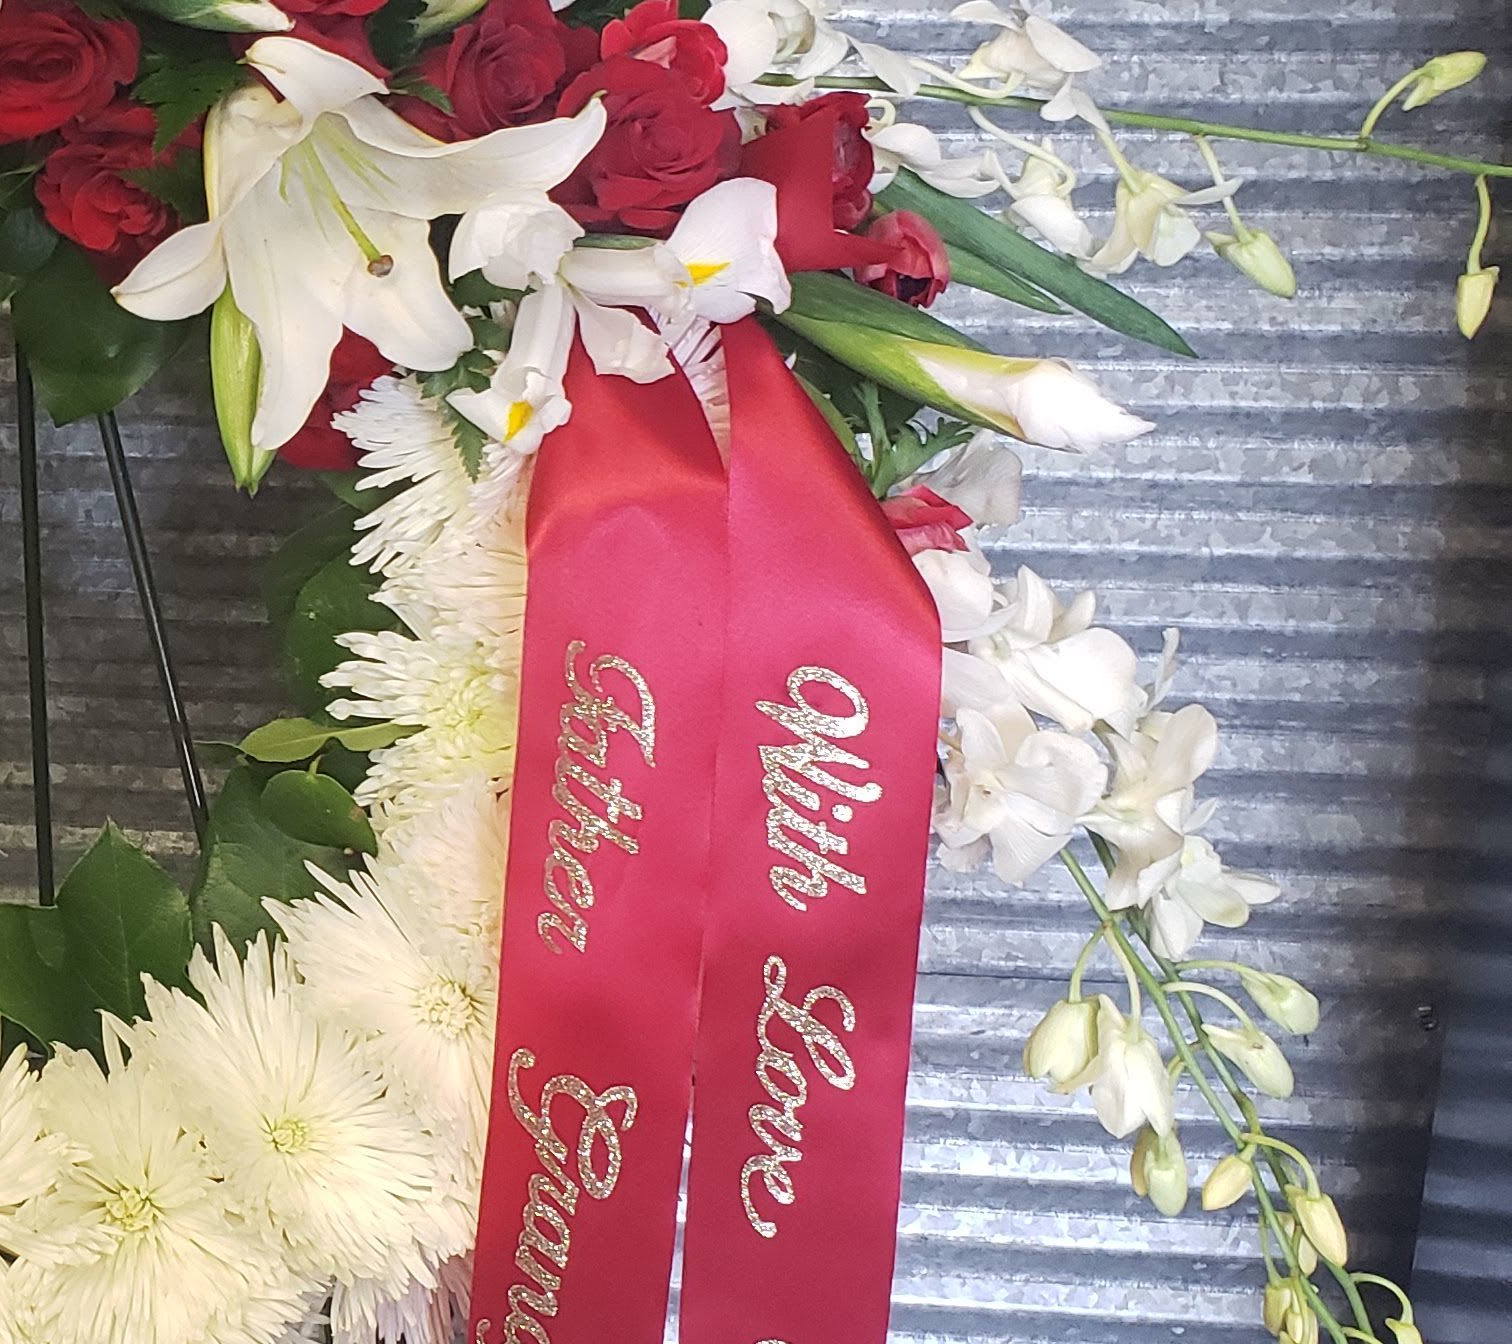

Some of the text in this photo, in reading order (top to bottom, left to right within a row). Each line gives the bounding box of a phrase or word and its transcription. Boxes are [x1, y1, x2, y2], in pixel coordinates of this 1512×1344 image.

[537, 640, 656, 955] Father
[755, 665, 884, 912] With
[740, 954, 856, 1239] Love
